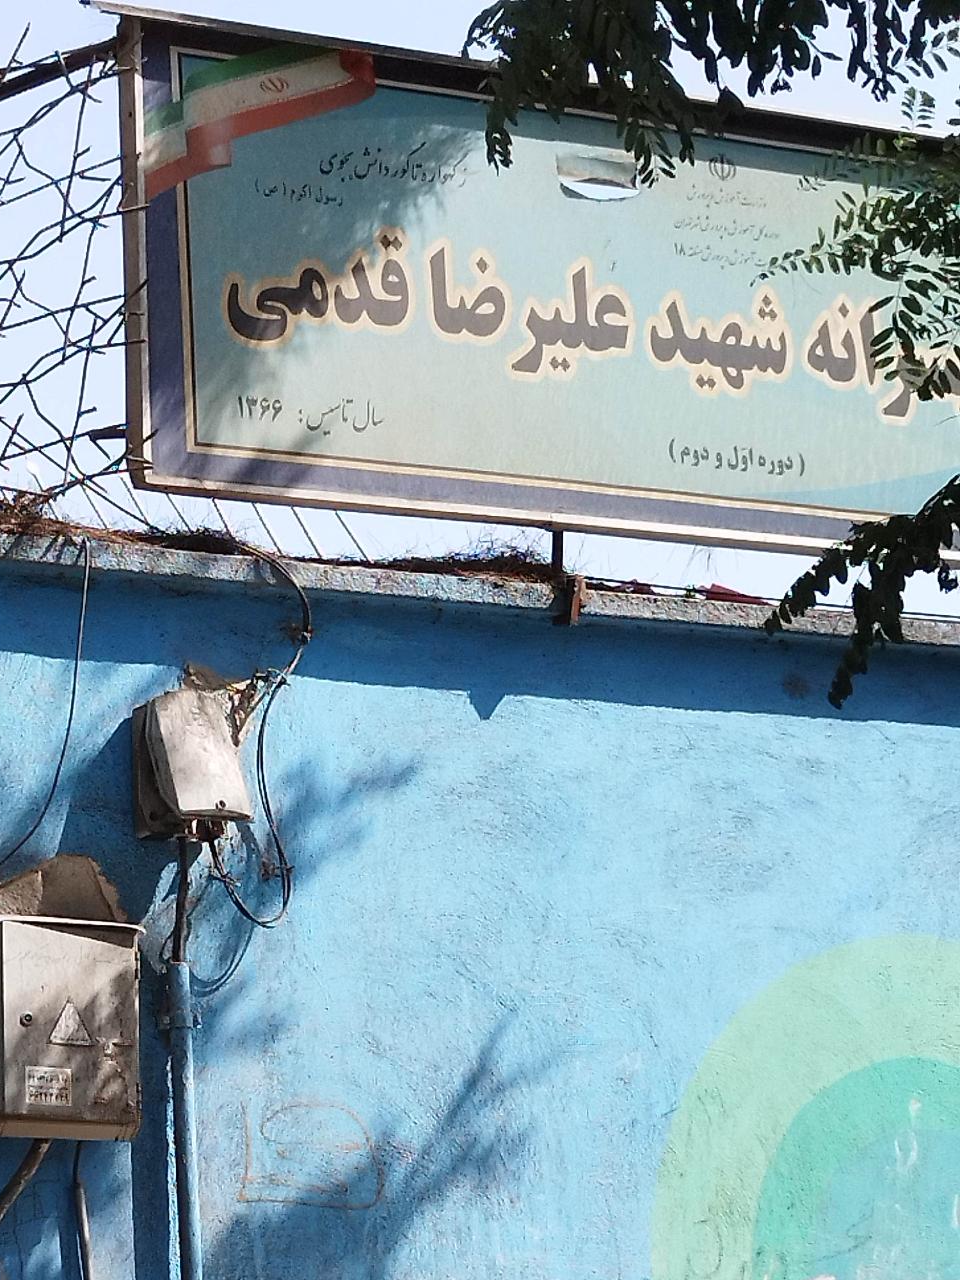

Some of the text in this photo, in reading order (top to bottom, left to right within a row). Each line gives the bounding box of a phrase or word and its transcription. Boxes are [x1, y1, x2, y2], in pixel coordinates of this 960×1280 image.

[226, 233, 410, 342] قدمی
[429, 246, 630, 374] علیرضا
[649, 294, 788, 390] شهید
[237, 394, 283, 423] ۱۳۶۶
[352, 399, 385, 433] سال
